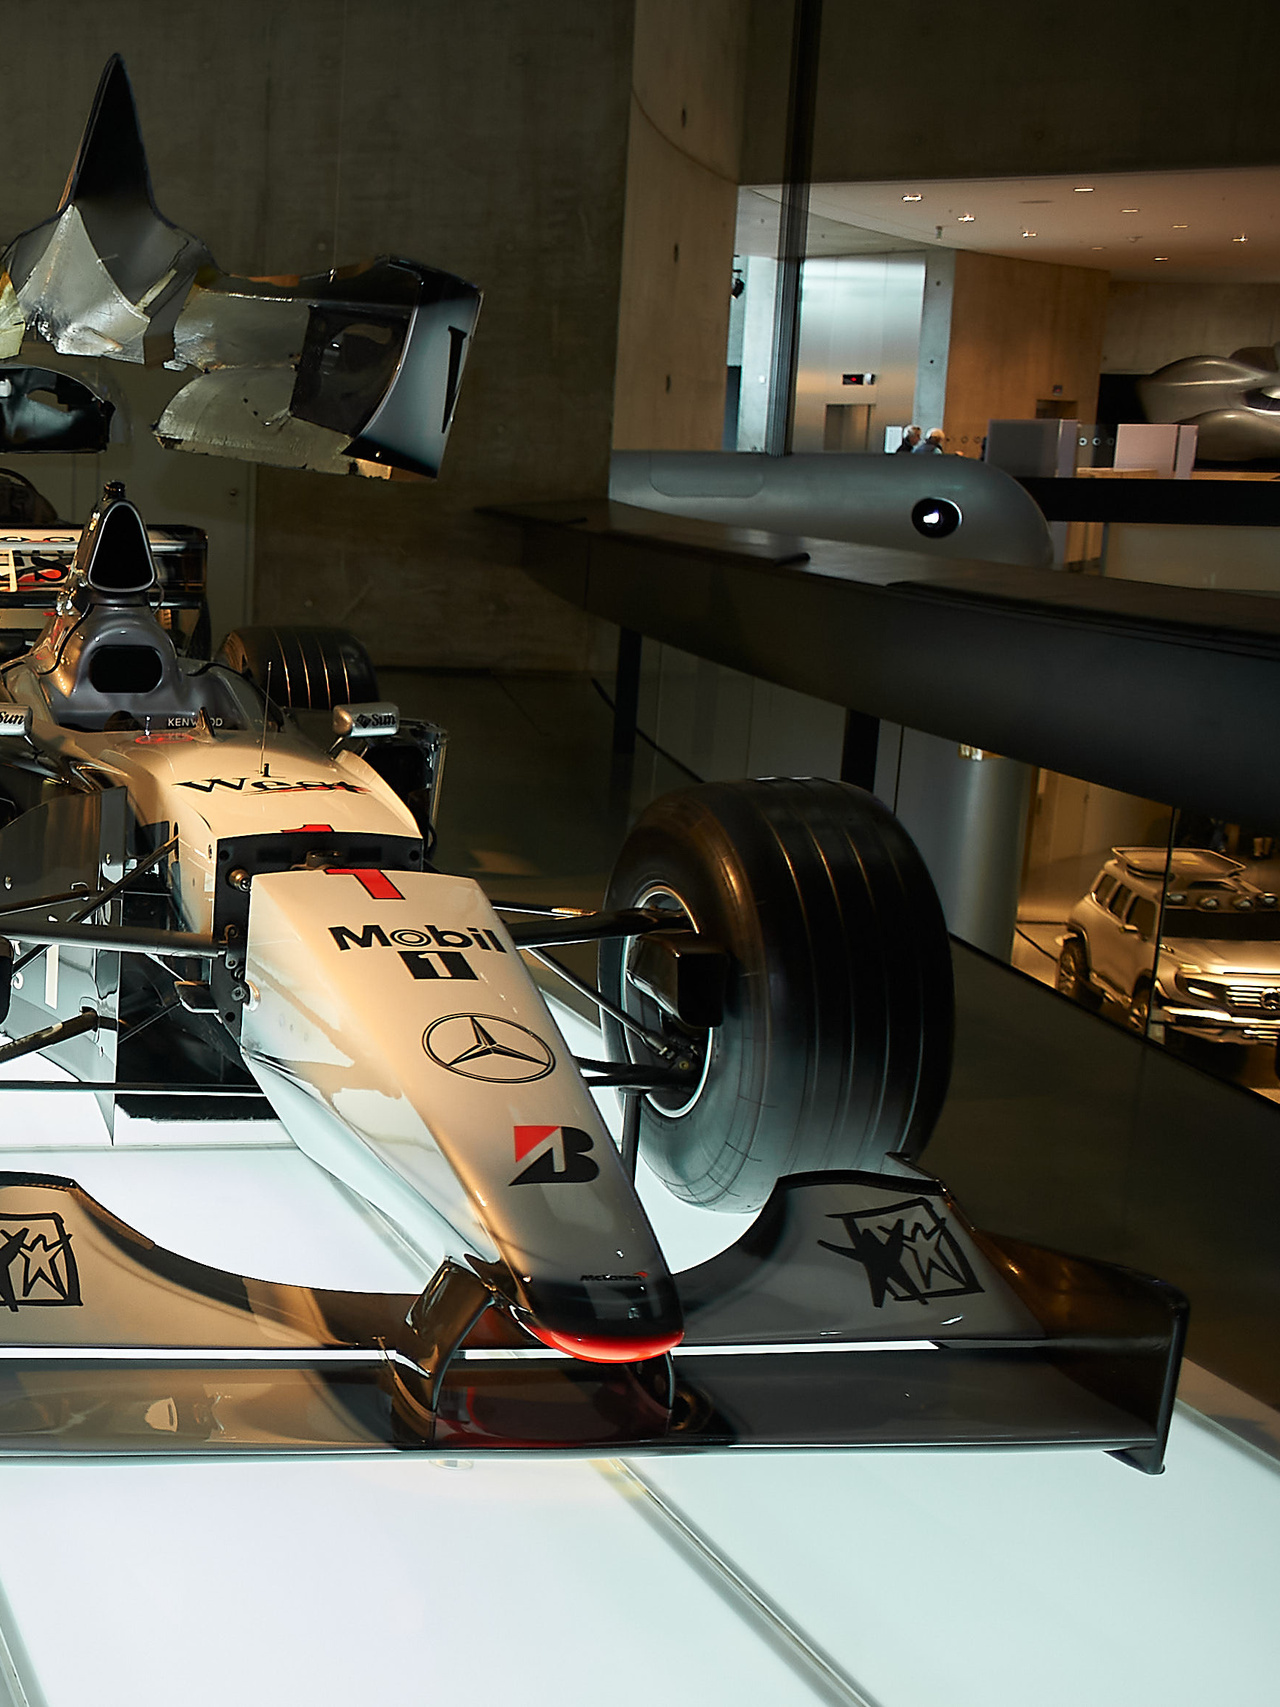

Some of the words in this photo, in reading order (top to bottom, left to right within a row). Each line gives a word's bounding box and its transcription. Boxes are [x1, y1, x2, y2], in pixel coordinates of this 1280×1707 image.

[167, 717, 223, 727] KENWOD
[371, 714, 396, 727] Sun
[328, 924, 507, 953] Mobil
